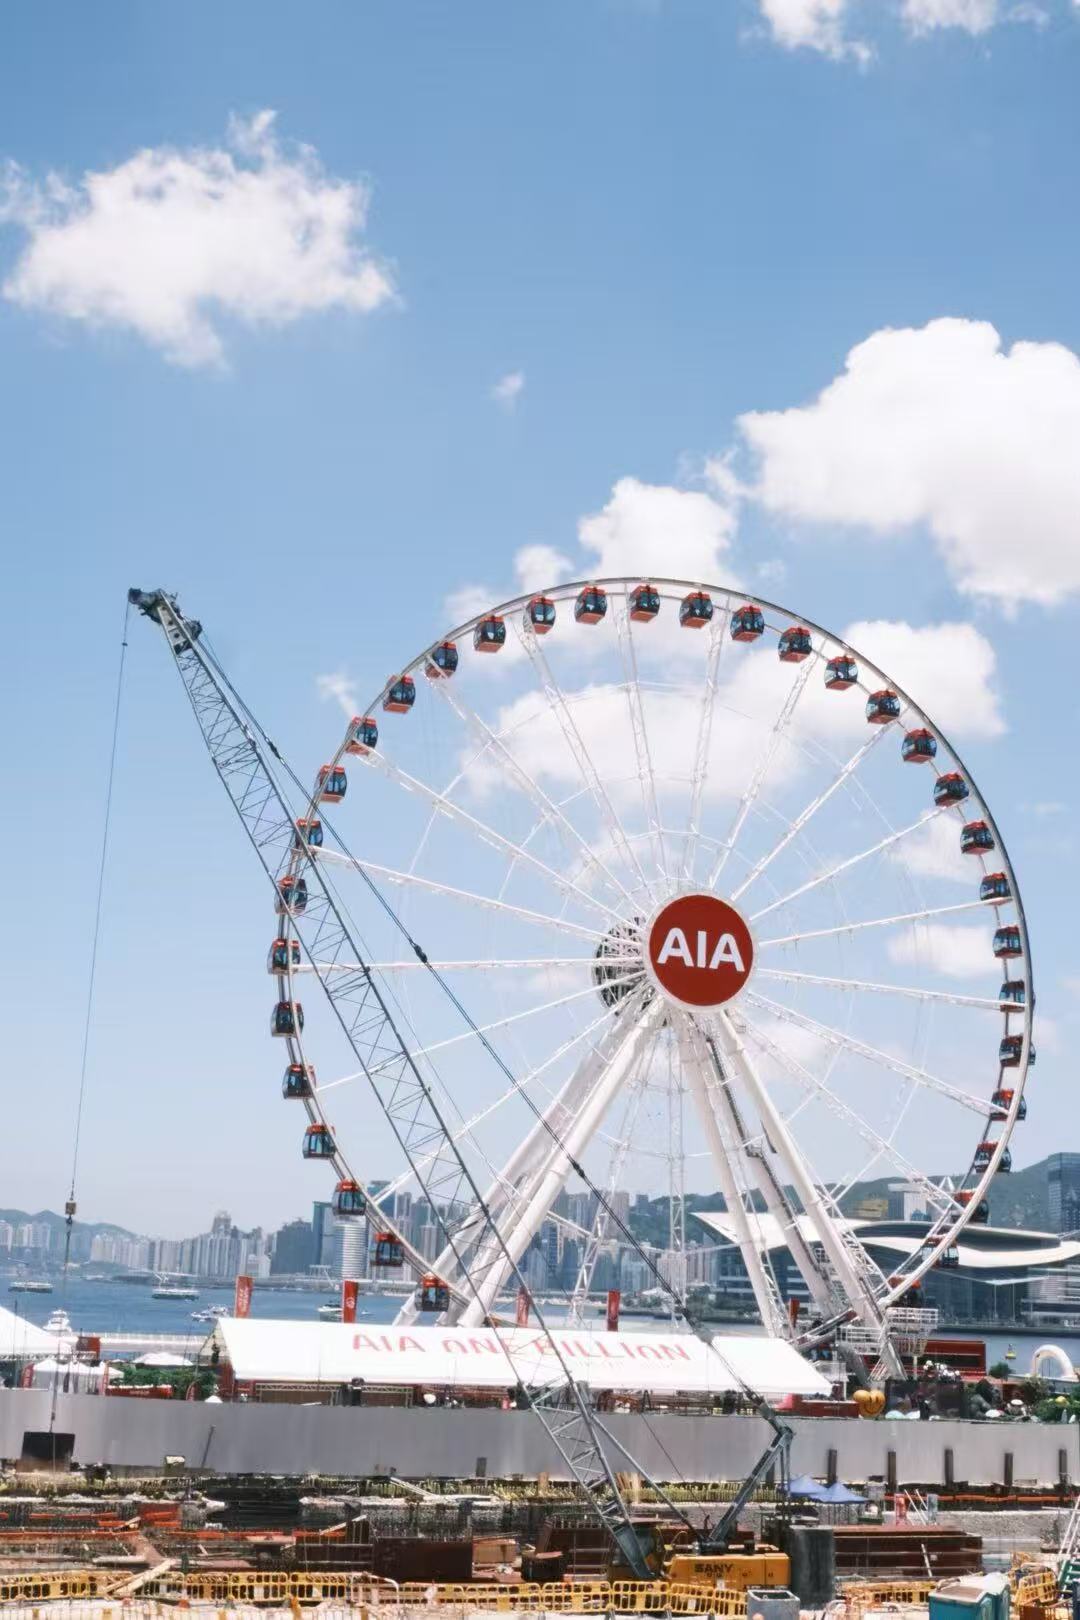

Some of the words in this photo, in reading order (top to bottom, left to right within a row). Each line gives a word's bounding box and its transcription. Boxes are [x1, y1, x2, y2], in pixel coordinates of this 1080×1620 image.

[657, 927, 745, 972] AIA
[352, 1333, 426, 1353] AIA
[695, 1564, 733, 1573] SANY
